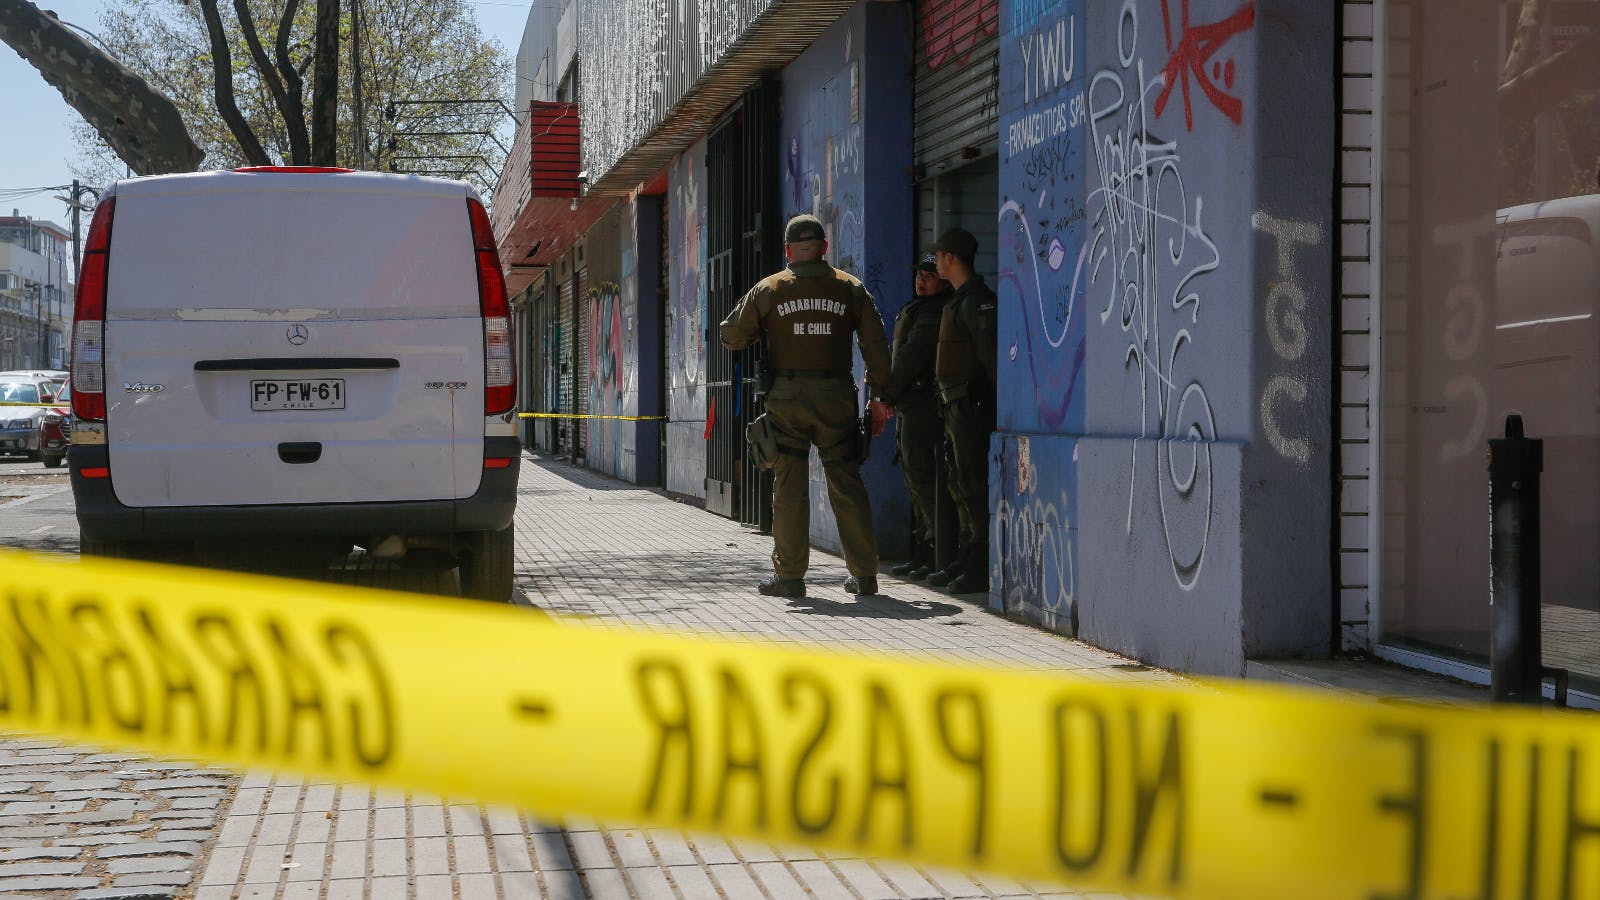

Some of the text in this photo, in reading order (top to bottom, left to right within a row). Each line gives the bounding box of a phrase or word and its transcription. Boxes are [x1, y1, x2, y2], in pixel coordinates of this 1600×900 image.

[1020, 14, 1075, 104] YIWU
[776, 298, 847, 317] CARABINEROS
[793, 322, 832, 335] DE CHILE
